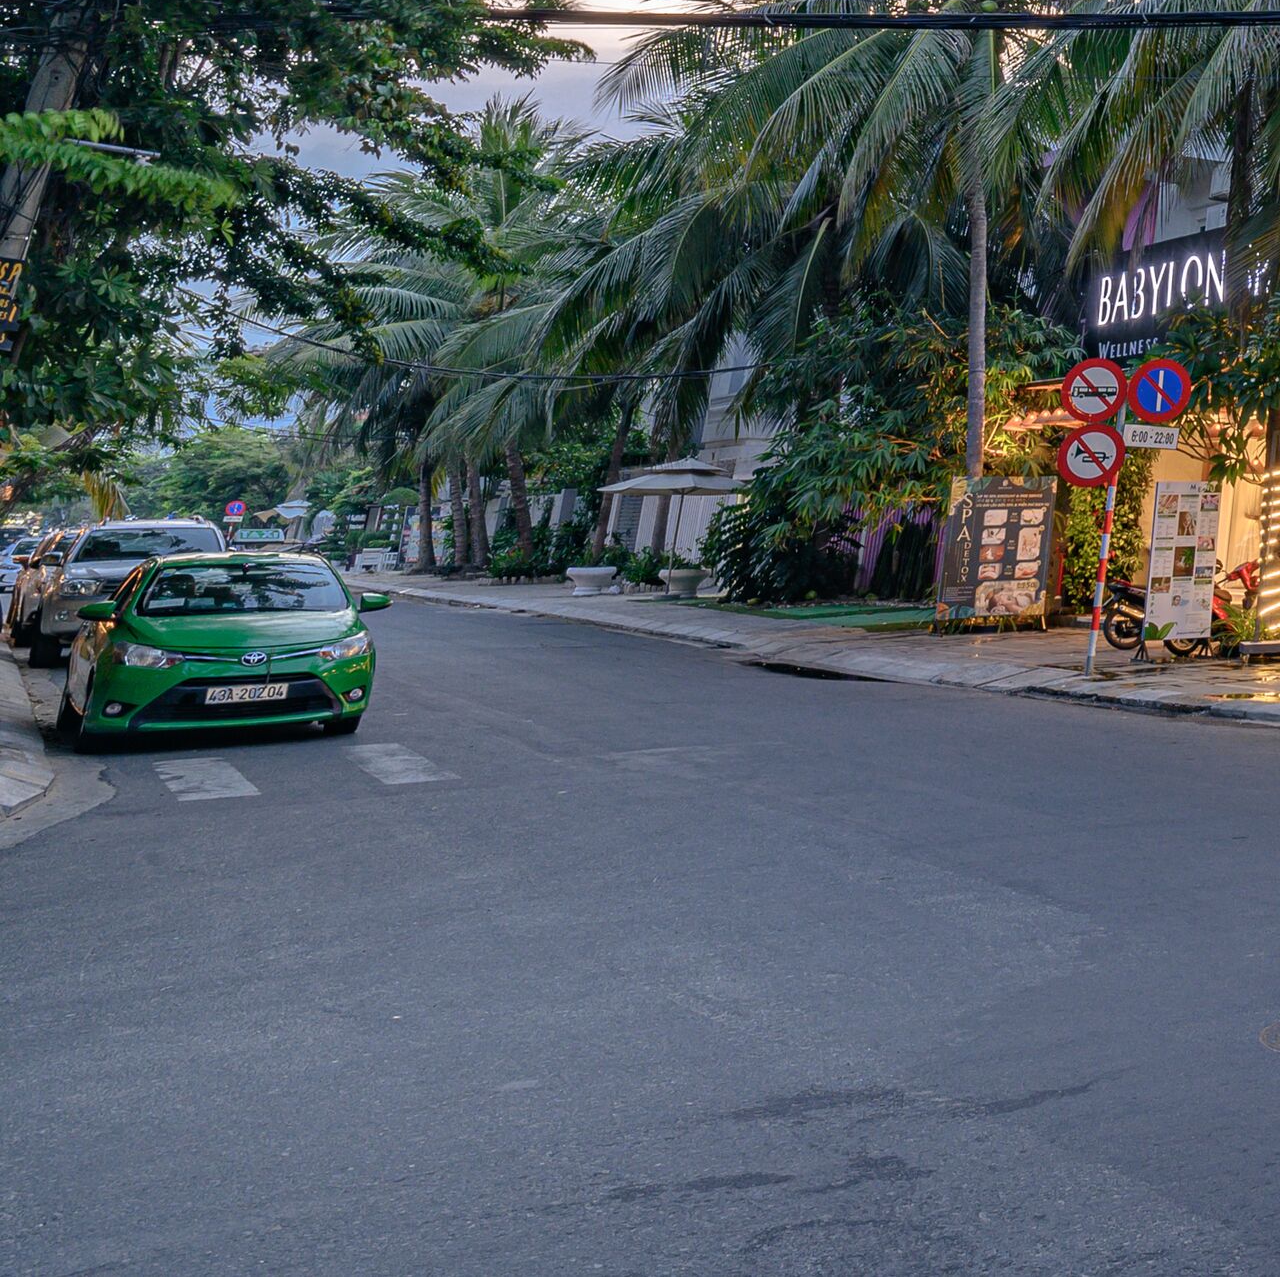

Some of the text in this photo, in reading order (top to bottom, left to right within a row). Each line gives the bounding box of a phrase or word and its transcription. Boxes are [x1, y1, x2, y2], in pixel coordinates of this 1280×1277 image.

[1131, 429, 1149, 443] 6:00
[1153, 431, 1175, 445] 22:00
[240, 530, 279, 539] TAXI
[960, 541, 972, 583] DETOX
